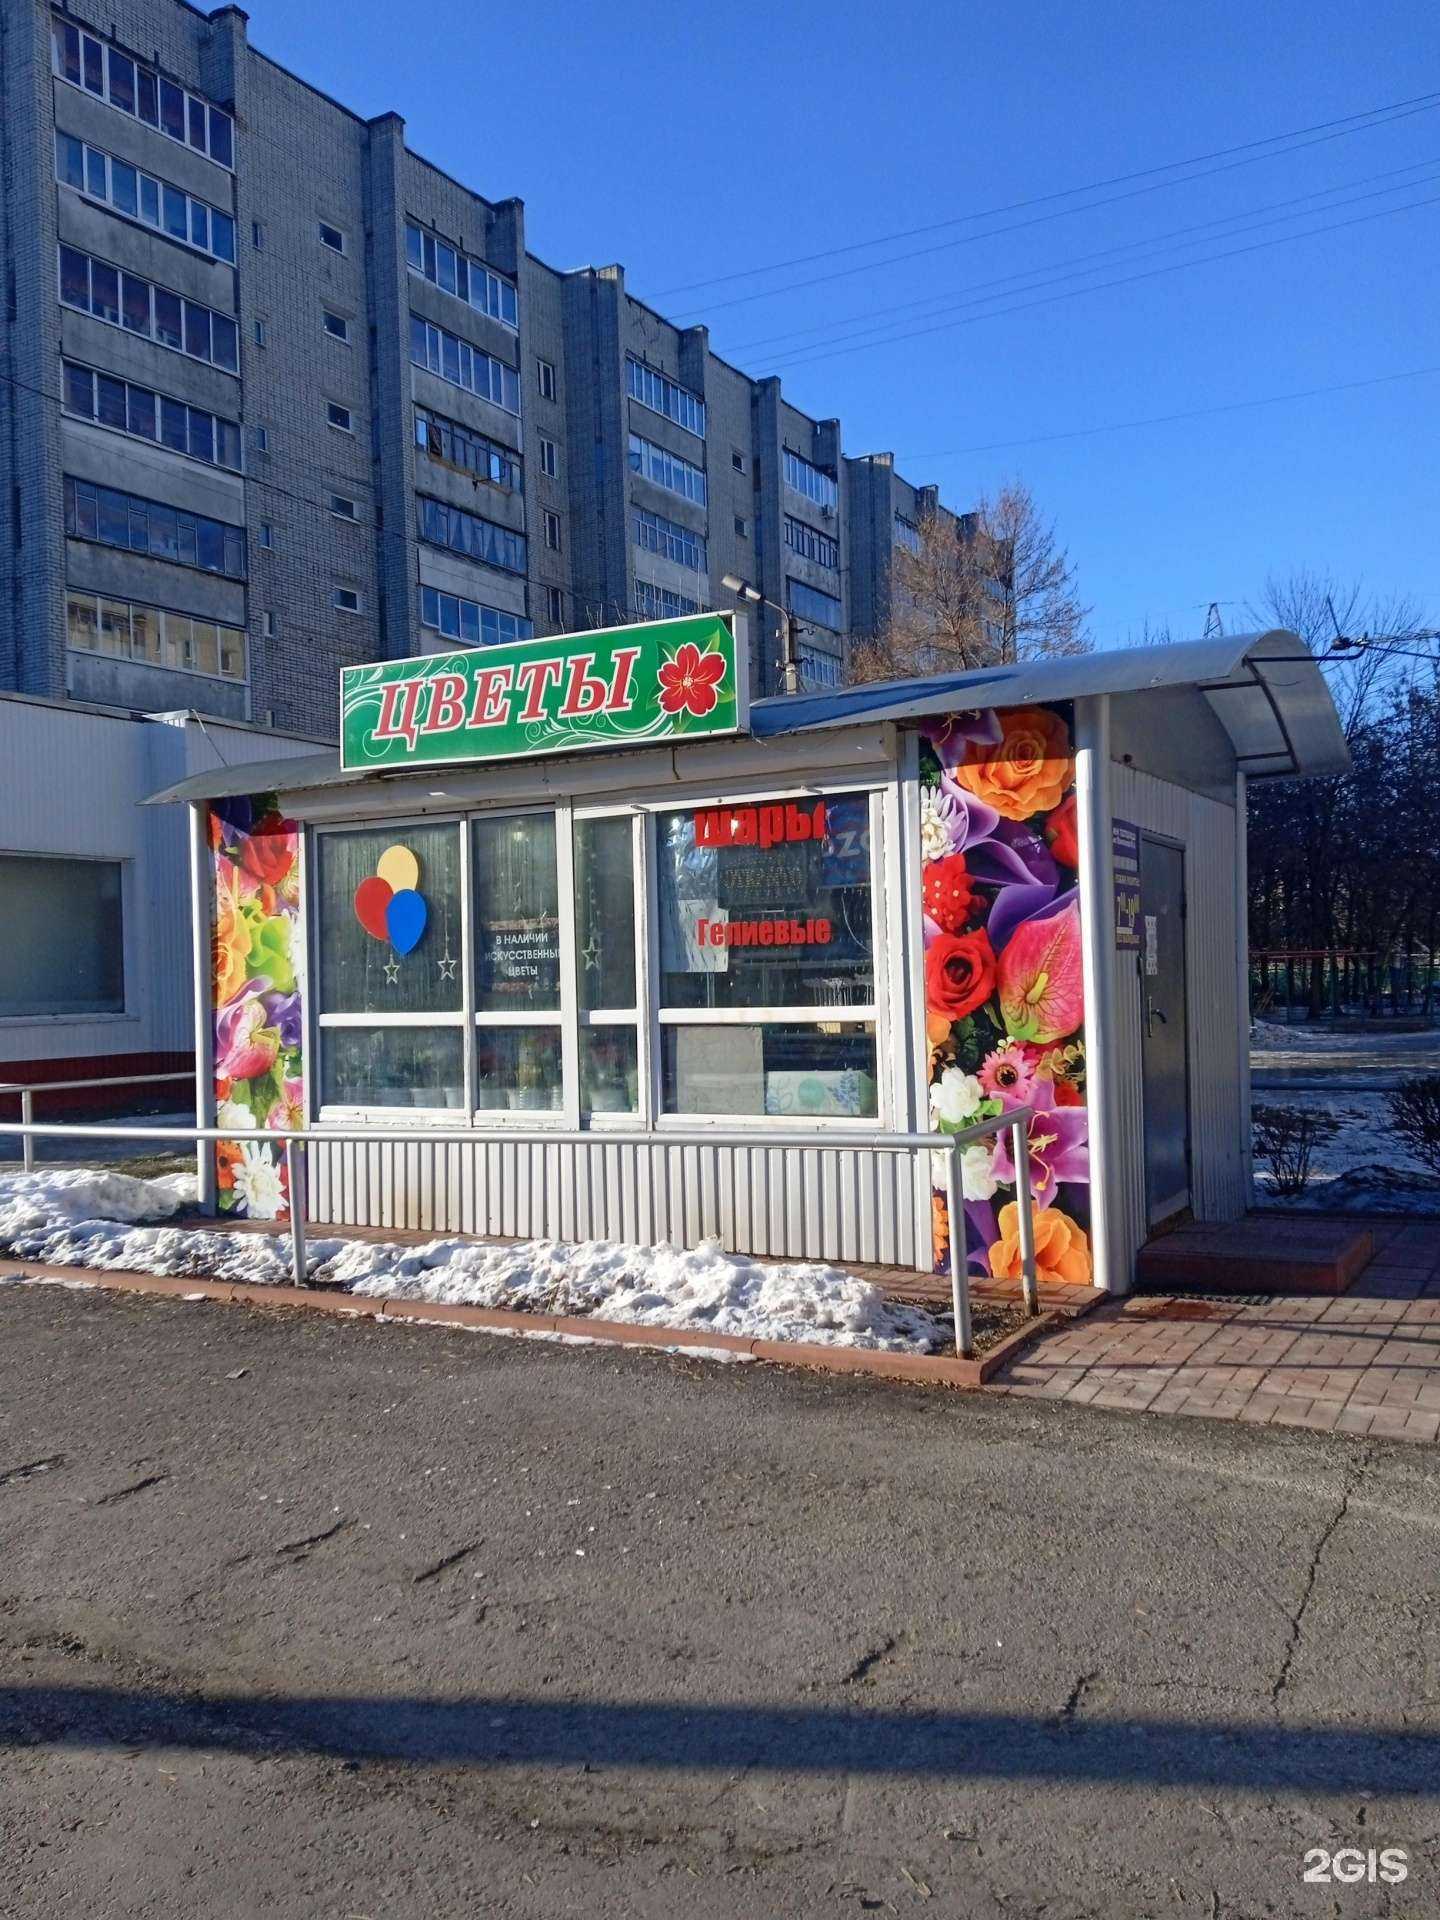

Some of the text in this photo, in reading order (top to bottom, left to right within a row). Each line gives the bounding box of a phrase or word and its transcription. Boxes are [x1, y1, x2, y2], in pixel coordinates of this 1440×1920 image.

[371, 647, 641, 751] ЦВЕТЫ
[496, 933, 548, 945] В НАЛИЧИИ
[695, 918, 833, 947] Гелиевые
[508, 966, 537, 977] ЦВЕТЫ
